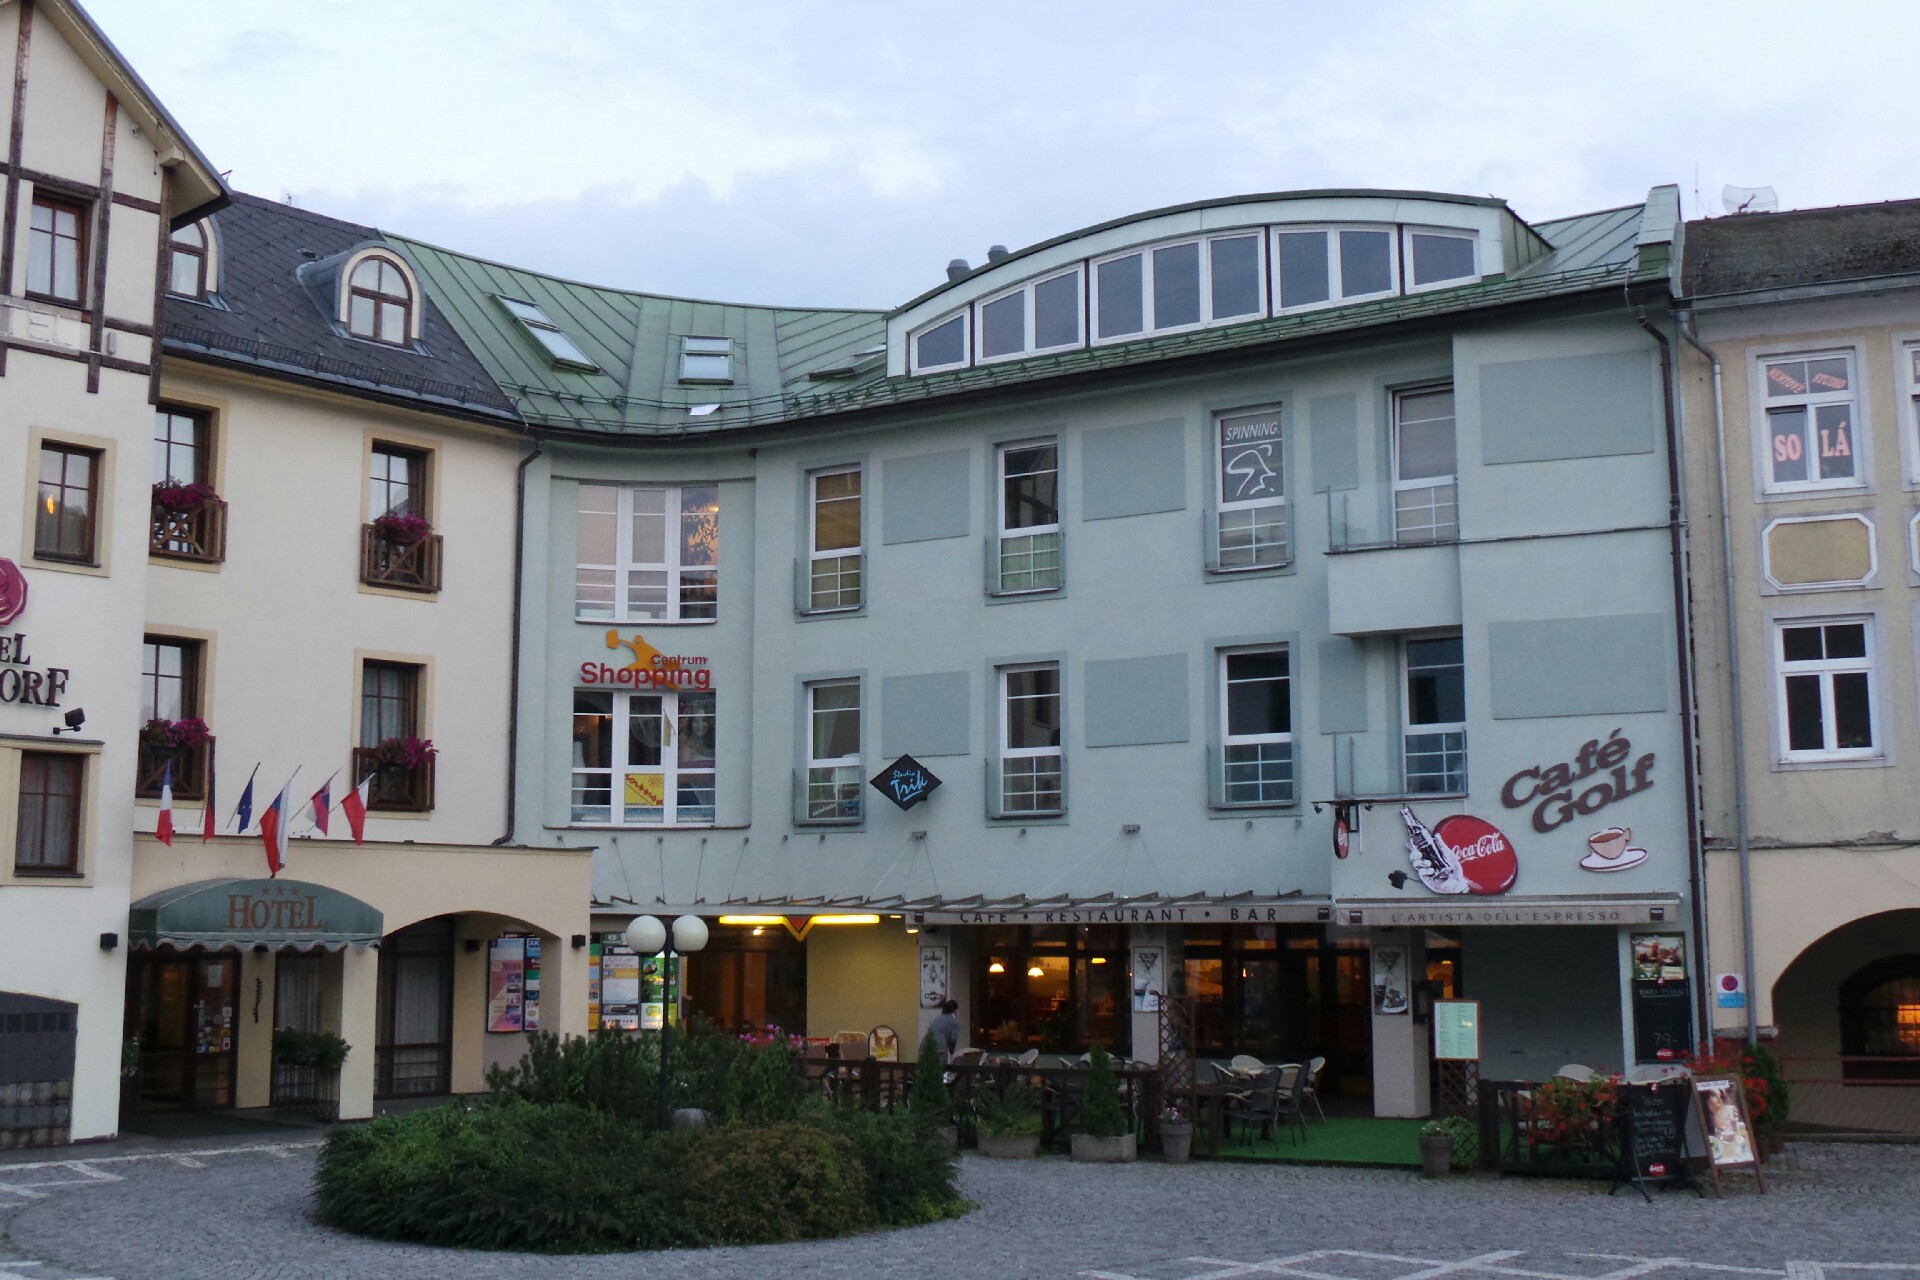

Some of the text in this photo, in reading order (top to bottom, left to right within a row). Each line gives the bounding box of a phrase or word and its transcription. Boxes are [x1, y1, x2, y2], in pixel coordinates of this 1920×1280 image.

[1225, 421, 1278, 440] SPINNING
[1774, 421, 1851, 462] SO LÁ
[651, 654, 708, 665] Centrum
[0, 668, 69, 707] ORF
[580, 662, 711, 691] Shopping
[893, 769, 916, 778] Studio
[1501, 728, 1631, 809] Café
[1532, 753, 1655, 833] Golf
[227, 894, 324, 929] HOTEL
[1046, 909, 1186, 922] RESTAURANT
[1230, 908, 1276, 920] BAR
[1392, 911, 1619, 922] L'ARTISTA DELL'ESPRESSO
